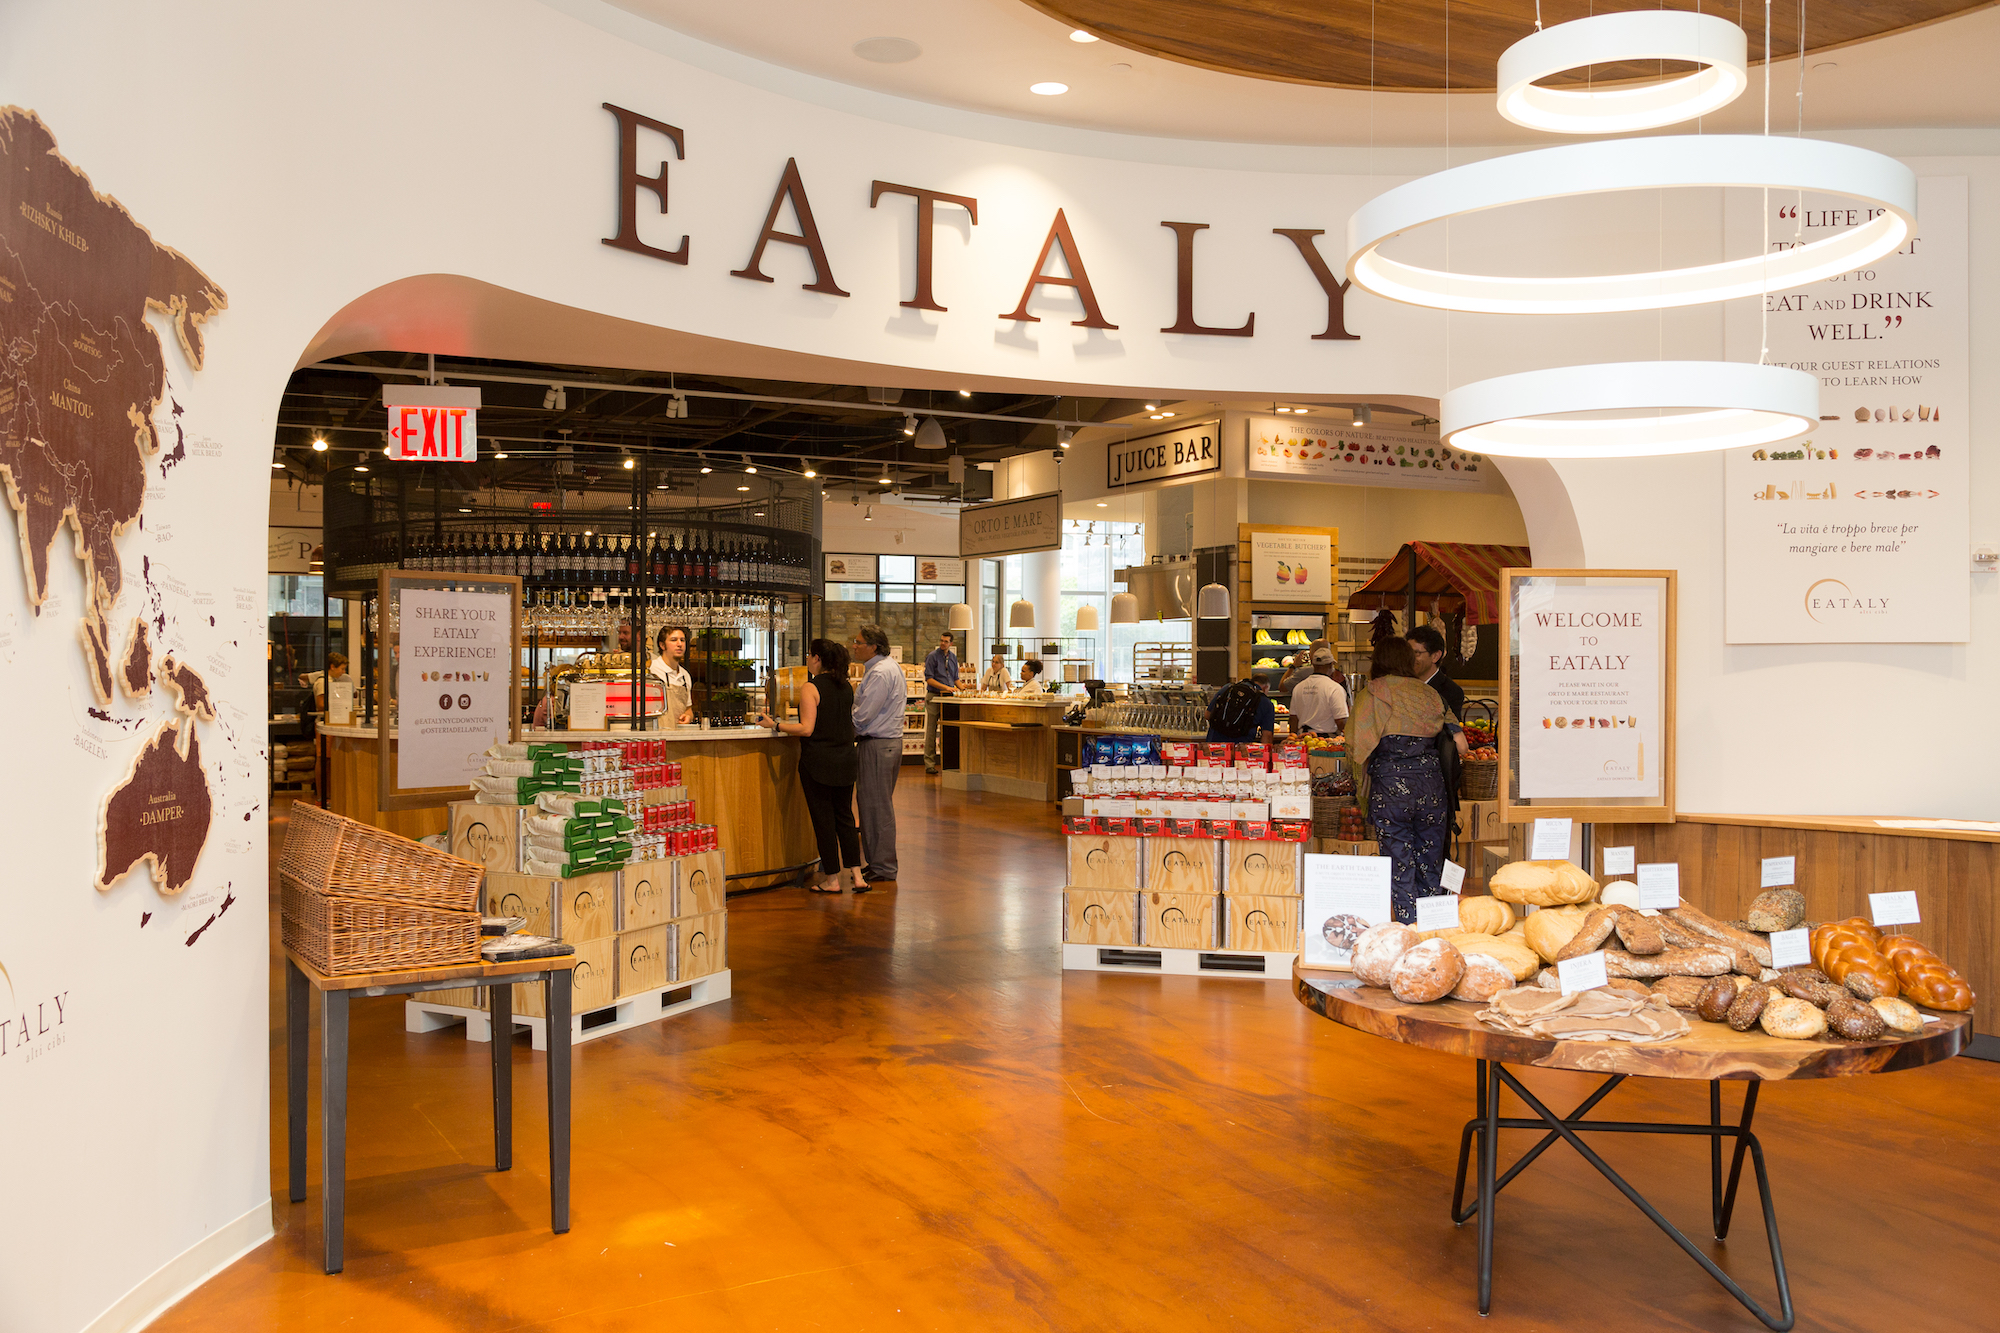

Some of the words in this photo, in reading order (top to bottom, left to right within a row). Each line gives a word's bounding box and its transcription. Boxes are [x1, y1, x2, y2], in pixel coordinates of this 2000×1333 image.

[20, 201, 58, 235] RIZHSKY
[59, 225, 89, 252] KHLEB
[601, 102, 1361, 341] EATALY
[1854, 270, 1876, 281] TO
[1762, 295, 1808, 312] EAT
[1812, 300, 1846, 310] AND
[1851, 292, 1933, 309] DRINK
[1790, 362, 1817, 371] OUR
[1822, 361, 1863, 370] GUEST
[1868, 359, 1940, 369] RELATIONS
[63, 378, 81, 394] China
[1822, 377, 1841, 386] TO
[1844, 377, 1888, 386] LEARN
[1892, 375, 1923, 385] HOW
[50, 390, 93, 418] MANTOU
[401, 407, 467, 458] EXIT
[1306, 428, 1333, 437] COLORS
[1346, 431, 1374, 439] NATURE:
[1114, 445, 1166, 481] JUICE
[1173, 436, 1213, 465] BAR
[974, 518, 1000, 534] ORTO
[1004, 516, 1010, 530] E
[1013, 511, 1042, 528] MARE
[1800, 524, 1819, 534] vita
[1831, 523, 1867, 537] troppo
[1870, 522, 1898, 533] breve
[1900, 524, 1919, 537] per
[155, 532, 173, 543] BAO
[1789, 543, 1838, 556] mangiare
[1850, 541, 1872, 552] bere
[160, 581, 192, 598] PANDESAL
[1813, 598, 1889, 608] EATALY
[415, 607, 458, 619] SHARE
[461, 609, 496, 621] YOUR
[1534, 612, 1642, 627] WELCOME
[433, 627, 480, 639] EATALY
[1579, 636, 1598, 646] TO
[414, 646, 496, 658] EXPERIENCE!
[1549, 655, 1630, 670] EATALY
[414, 717, 494, 726] @EATALYNYCDOWNTOWN
[420, 726, 488, 735] @OSTERIADELLAPACE
[74, 734, 108, 760] BAGELEN
[148, 791, 177, 805] Australia
[140, 805, 184, 826] DAMPER
[470, 834, 507, 842] EATALY
[693, 878, 716, 887] EATALY
[504, 905, 540, 914] EATALY
[577, 900, 606, 910] EATALY
[693, 938, 718, 949] EATALY
[633, 952, 660, 964] EATALY
[26, 1044, 42, 1063] alti
[47, 1031, 66, 1051] cibi
